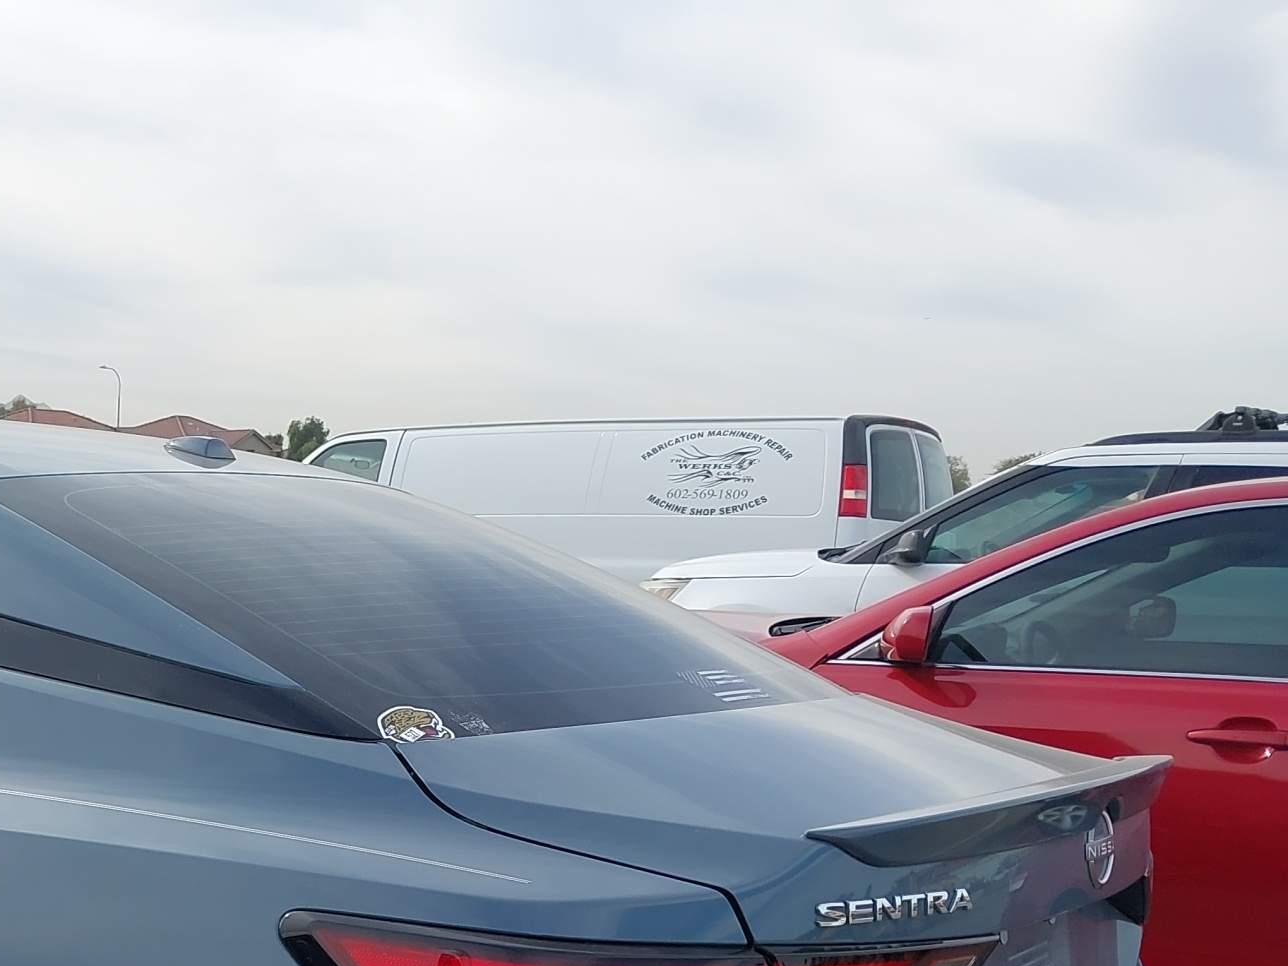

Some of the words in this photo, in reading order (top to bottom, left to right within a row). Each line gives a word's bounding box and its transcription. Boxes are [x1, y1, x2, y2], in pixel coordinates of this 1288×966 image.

[641, 431, 704, 461] FABRICATION
[707, 430, 765, 443] MACHINERY
[763, 438, 793, 461] REPAIR
[646, 494, 688, 515] MACHINE
[689, 508, 717, 516] SHOP
[719, 495, 768, 515] SERVICES
[666, 488, 749, 500] 602-569-1809
[815, 888, 973, 927] SENTRA
